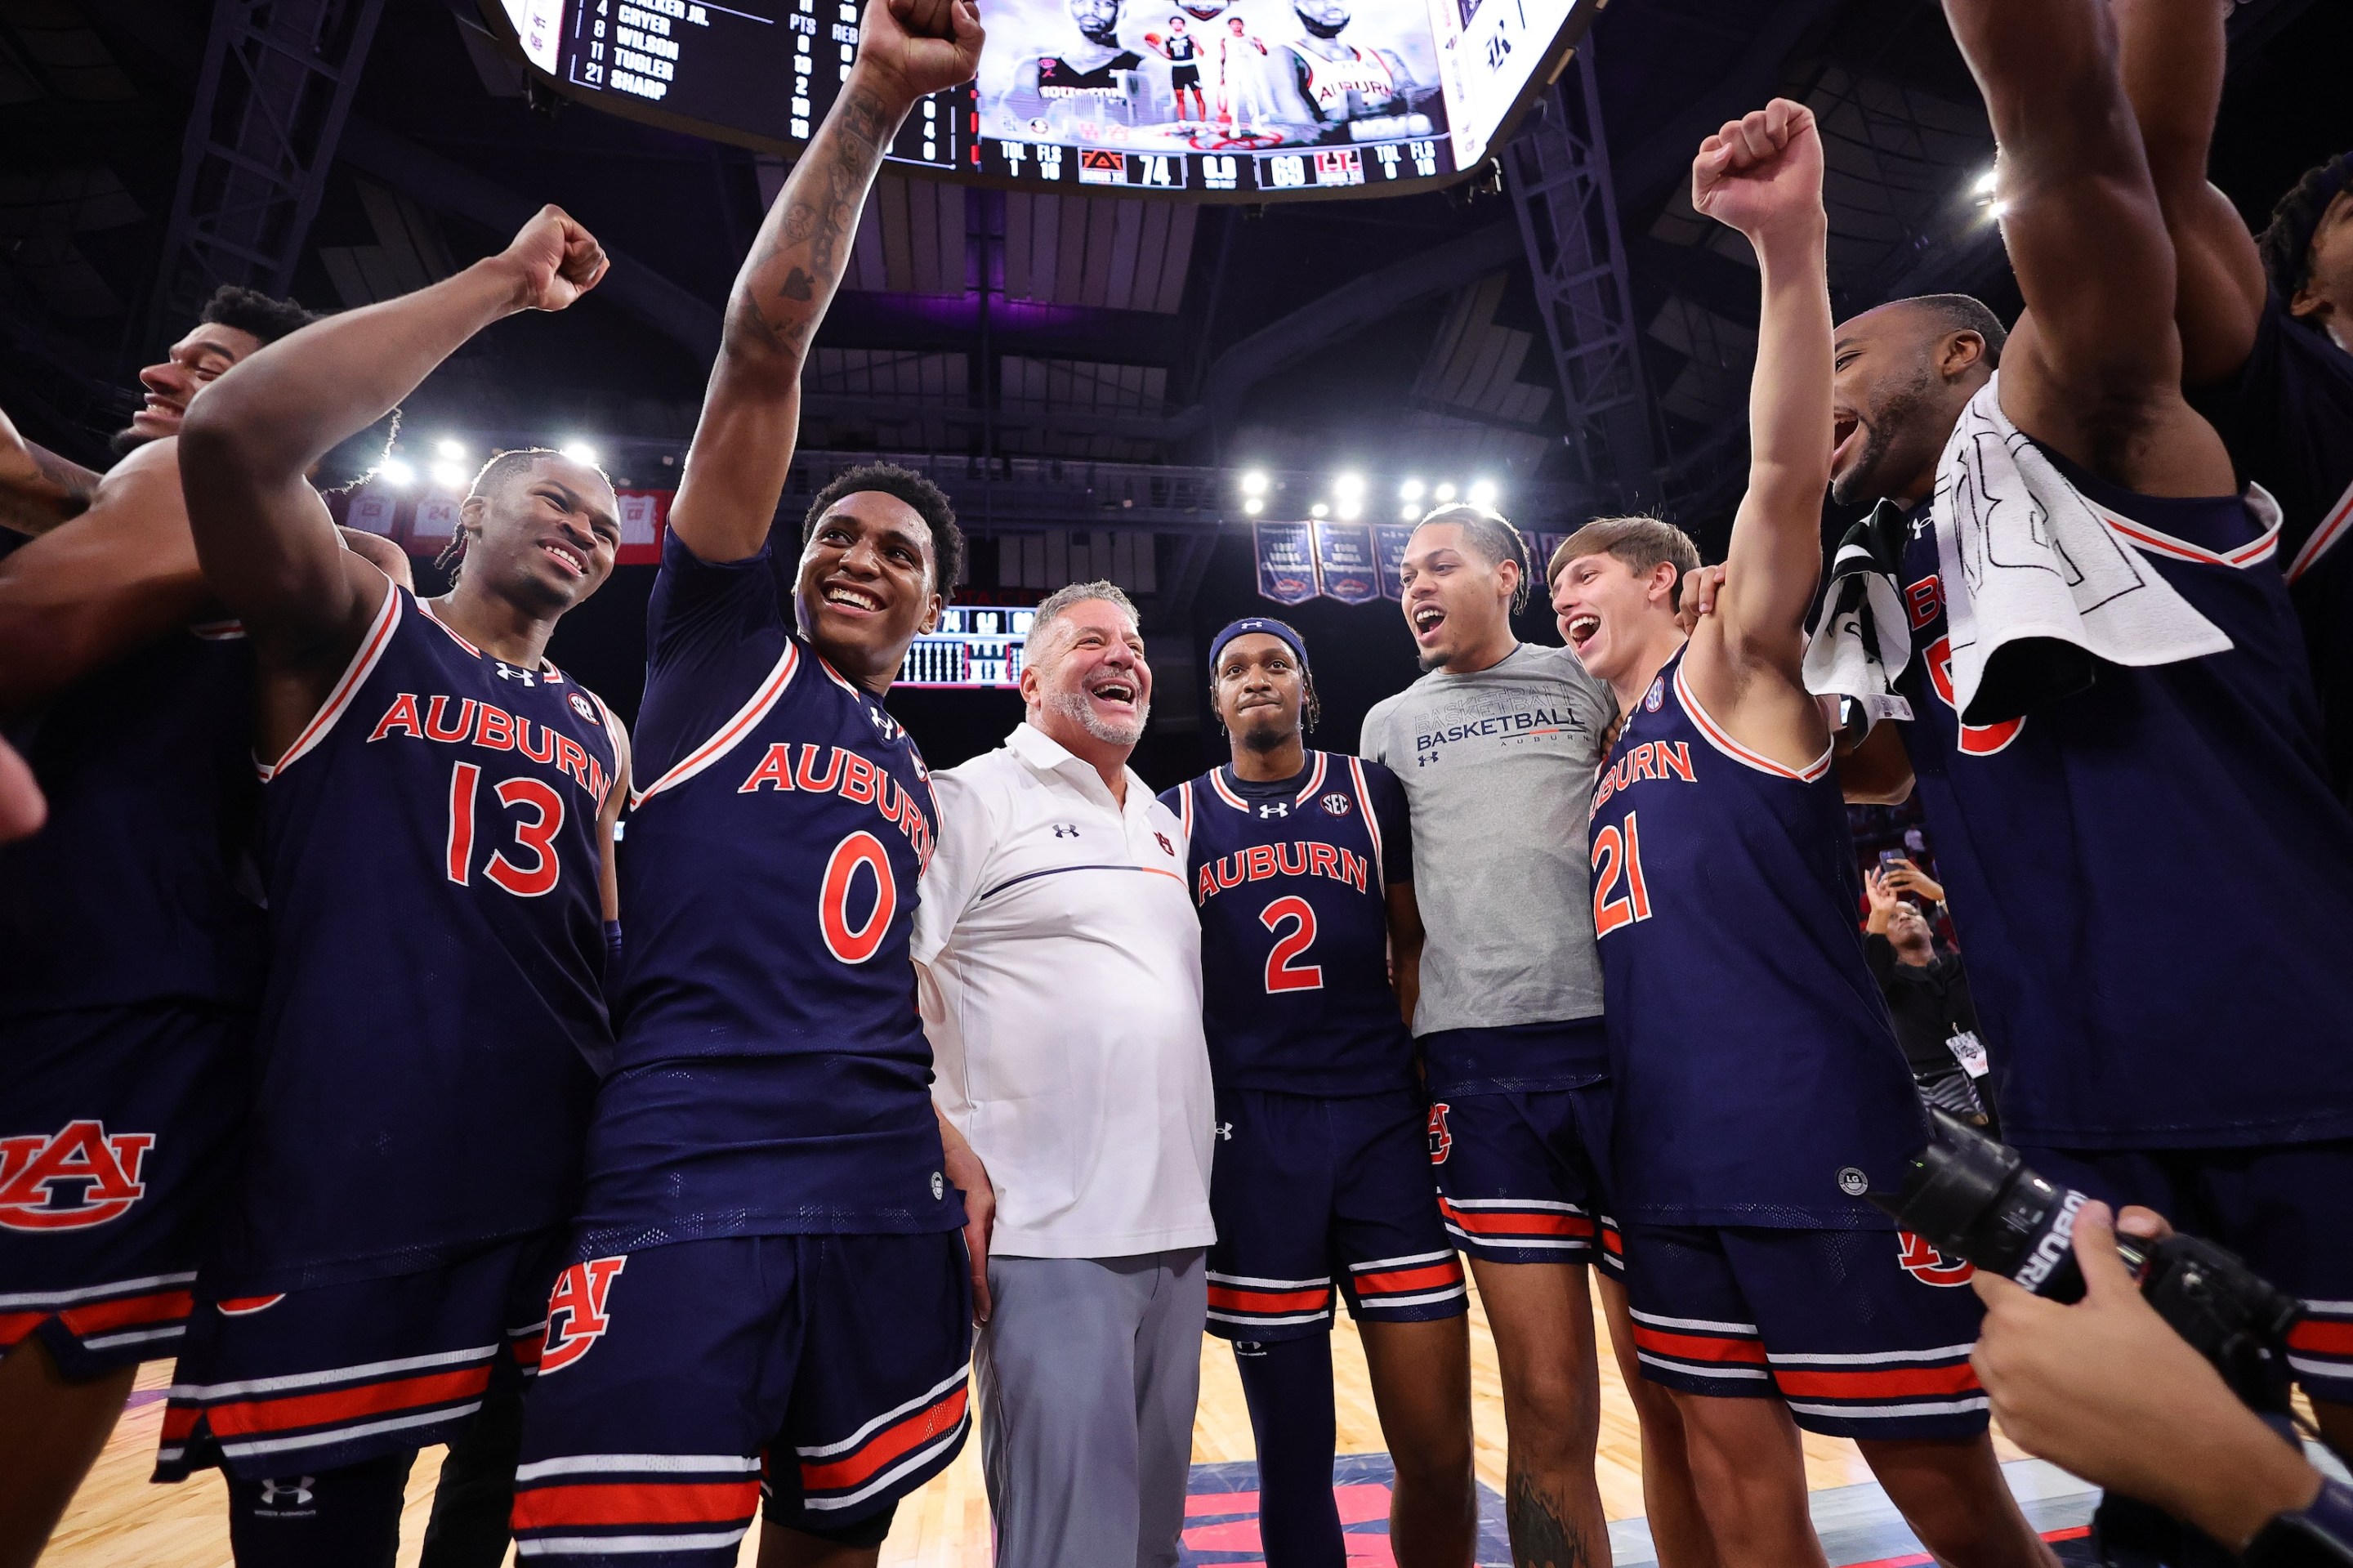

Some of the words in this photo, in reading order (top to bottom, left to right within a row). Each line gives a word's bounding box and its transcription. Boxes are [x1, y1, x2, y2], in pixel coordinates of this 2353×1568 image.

[596, 0, 609, 16] 4
[618, 4, 671, 37] CRYER
[622, 0, 685, 20] LKER
[686, 5, 710, 27] JR.
[789, 13, 816, 35] PTS
[832, 24, 859, 44] REB
[591, 40, 604, 60] 11
[614, 47, 674, 82] TUGLER
[593, 19, 606, 38] 8
[616, 25, 679, 61] WILSON
[796, 76, 808, 96] 2
[585, 62, 604, 84] 21
[610, 69, 667, 101] SHARP
[1001, 141, 1027, 161] TOL
[1037, 144, 1062, 163] FLS
[1010, 160, 1019, 177] 1
[1374, 144, 1402, 163] TOL
[1409, 141, 1435, 160] FLS
[1138, 155, 1172, 185] 74
[1270, 155, 1306, 186] 69
[942, 610, 962, 632] 74
[570, 695, 597, 724] SEC
[1416, 708, 1586, 752] BASKETBALL
[1500, 734, 1590, 747] AUBURN
[366, 693, 611, 821] AUBURN
[737, 743, 935, 885] AUBURN
[1322, 793, 1350, 815] SEC
[447, 761, 565, 897] 13
[1198, 841, 1367, 907] AUBURN
[1591, 810, 1653, 940] 21
[818, 830, 897, 964] 0
[1258, 896, 1324, 994] 2
[1846, 1175, 1860, 1183] LG
